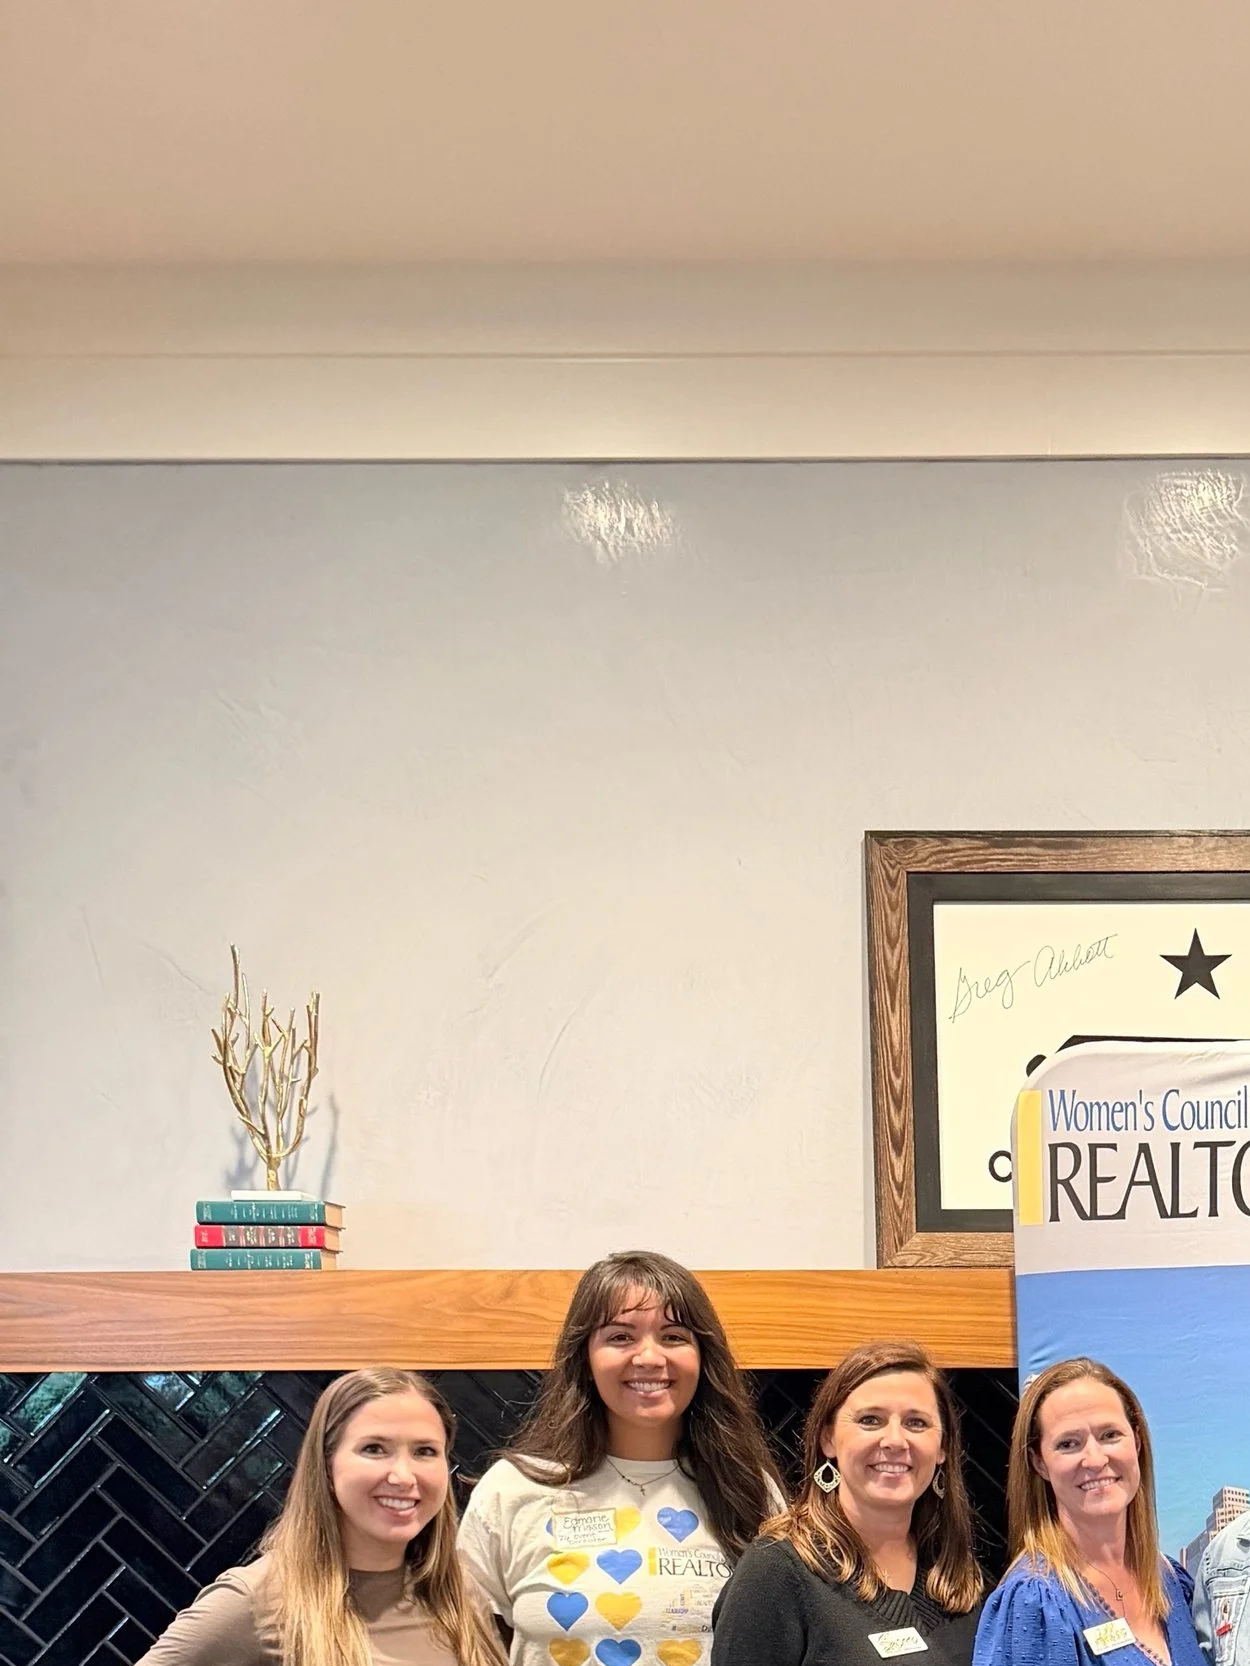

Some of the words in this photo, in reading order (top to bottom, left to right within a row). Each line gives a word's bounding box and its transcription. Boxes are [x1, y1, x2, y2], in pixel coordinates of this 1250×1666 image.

[948, 967, 1030, 1023] Greg
[1033, 933, 1118, 987] Abbott
[1048, 1089, 1155, 1131] Women's
[1162, 1085, 1248, 1131] Council
[659, 1557, 733, 1578] REALTO
